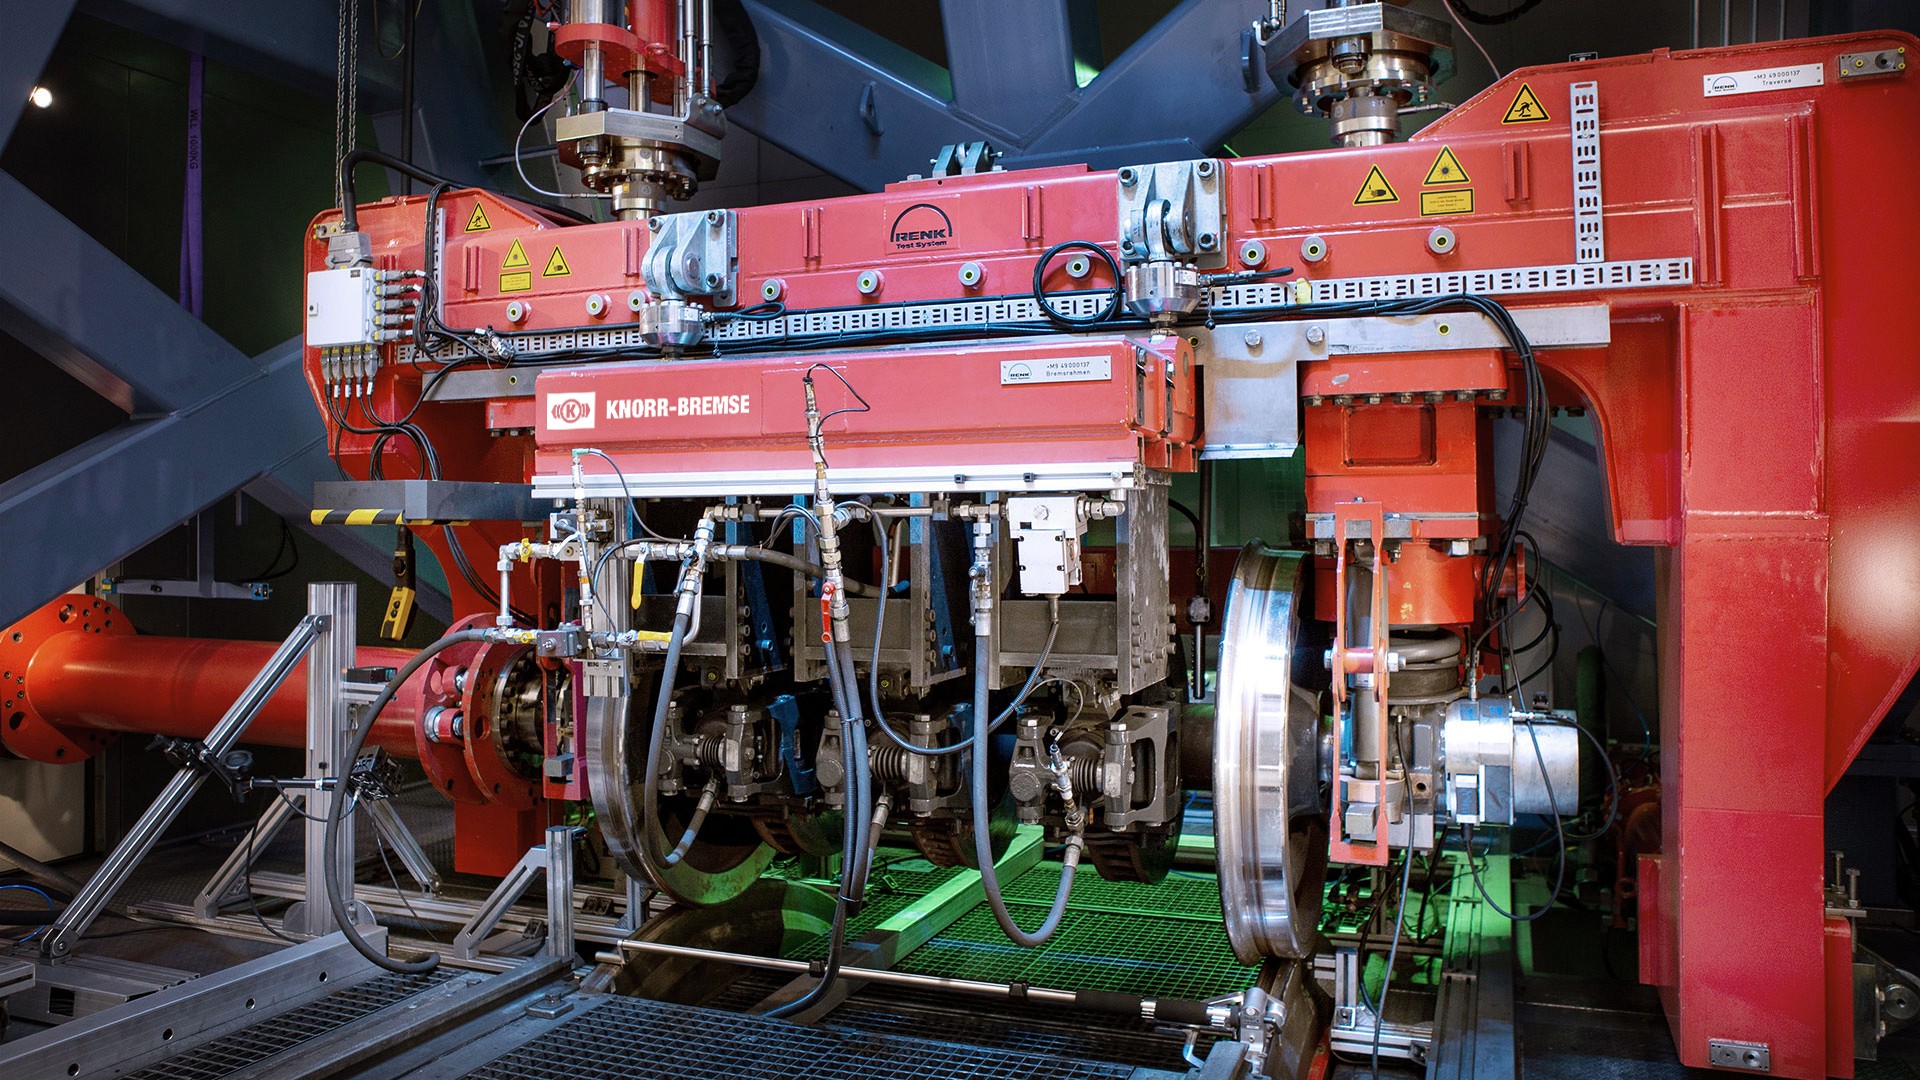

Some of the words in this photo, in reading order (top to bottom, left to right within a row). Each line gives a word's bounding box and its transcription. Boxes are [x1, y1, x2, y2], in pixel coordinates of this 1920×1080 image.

[190, 109, 199, 129] WLL
[189, 135, 199, 169] 1000KG
[896, 229, 946, 242] RENK
[915, 240, 947, 248] System
[606, 395, 750, 419] KNORR-BREMSE
